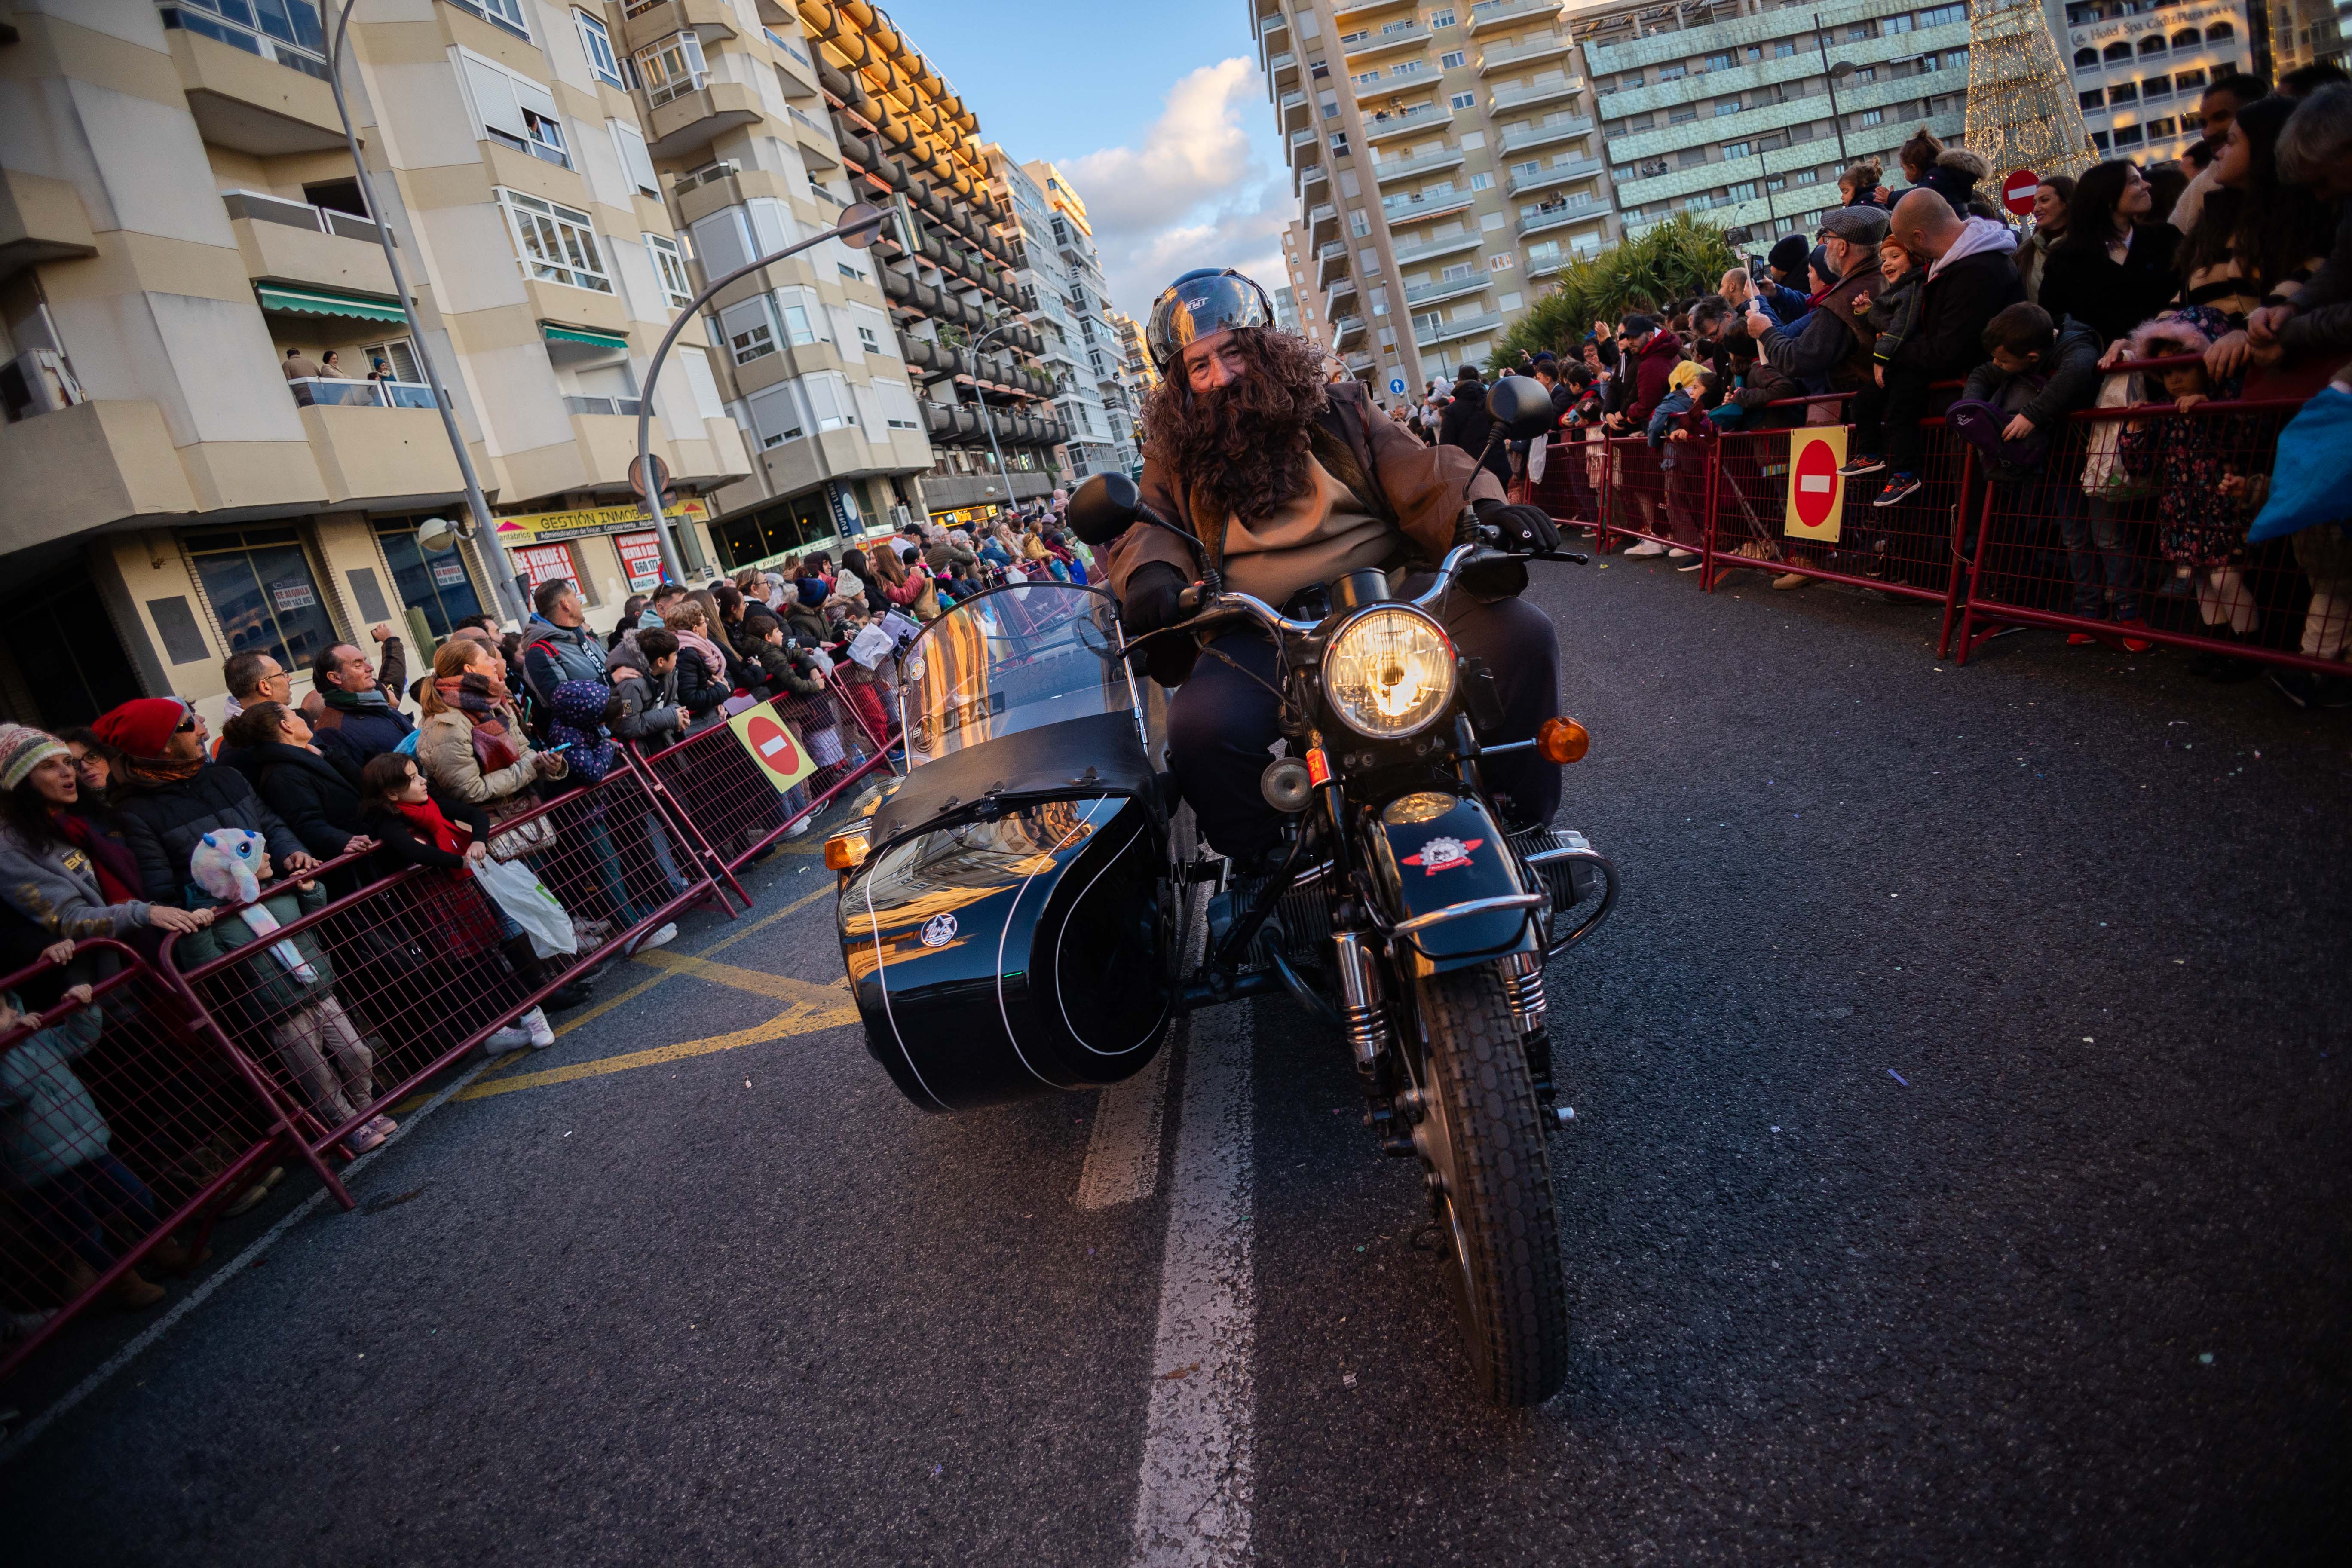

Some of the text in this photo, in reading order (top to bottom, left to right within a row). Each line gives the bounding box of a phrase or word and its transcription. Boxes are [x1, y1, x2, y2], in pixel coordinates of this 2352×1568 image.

[2090, 10, 2204, 41] Hotel Spa Cádiz Plaza
[541, 511, 596, 529] GESTIÓN
[835, 505, 848, 531] BUFFET
[499, 531, 531, 542] antábrico
[541, 528, 579, 539] Administración
[514, 546, 569, 569] SE VENDE O
[622, 546, 643, 560] VENTA
[640, 545, 648, 557] O
[534, 562, 575, 582] ALQUILA
[275, 587, 309, 599] SE ALQUILA
[941, 698, 1001, 732] URAL
[1311, 760, 1320, 772] 24
